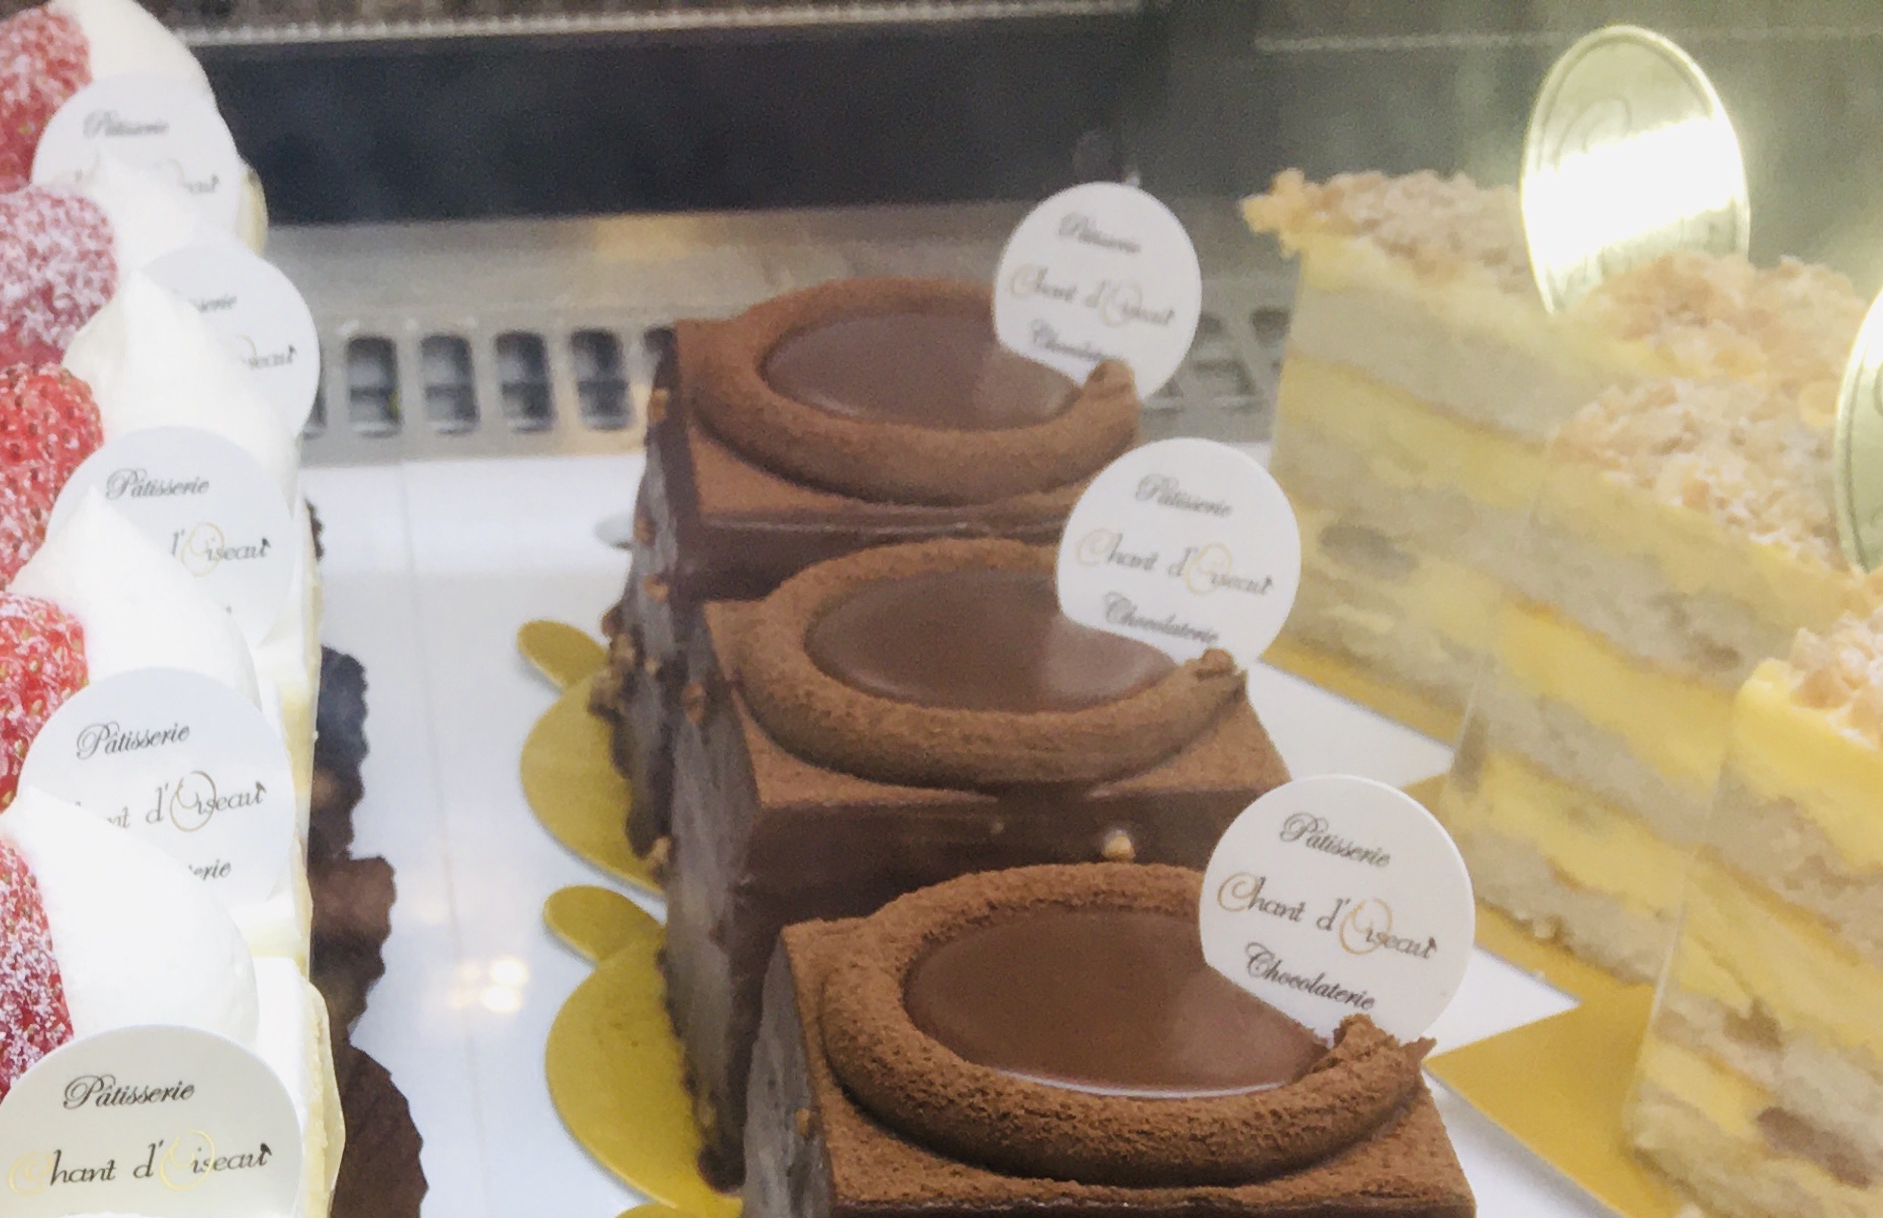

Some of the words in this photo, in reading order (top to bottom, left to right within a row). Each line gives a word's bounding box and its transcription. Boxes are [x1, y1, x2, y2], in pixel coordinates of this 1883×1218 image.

[1218, 872, 1306, 923] Chant
[1245, 942, 1375, 1010] Chocolaterie
[63, 1074, 195, 1110] Pâtisserie
[8, 1149, 116, 1194] Chant
